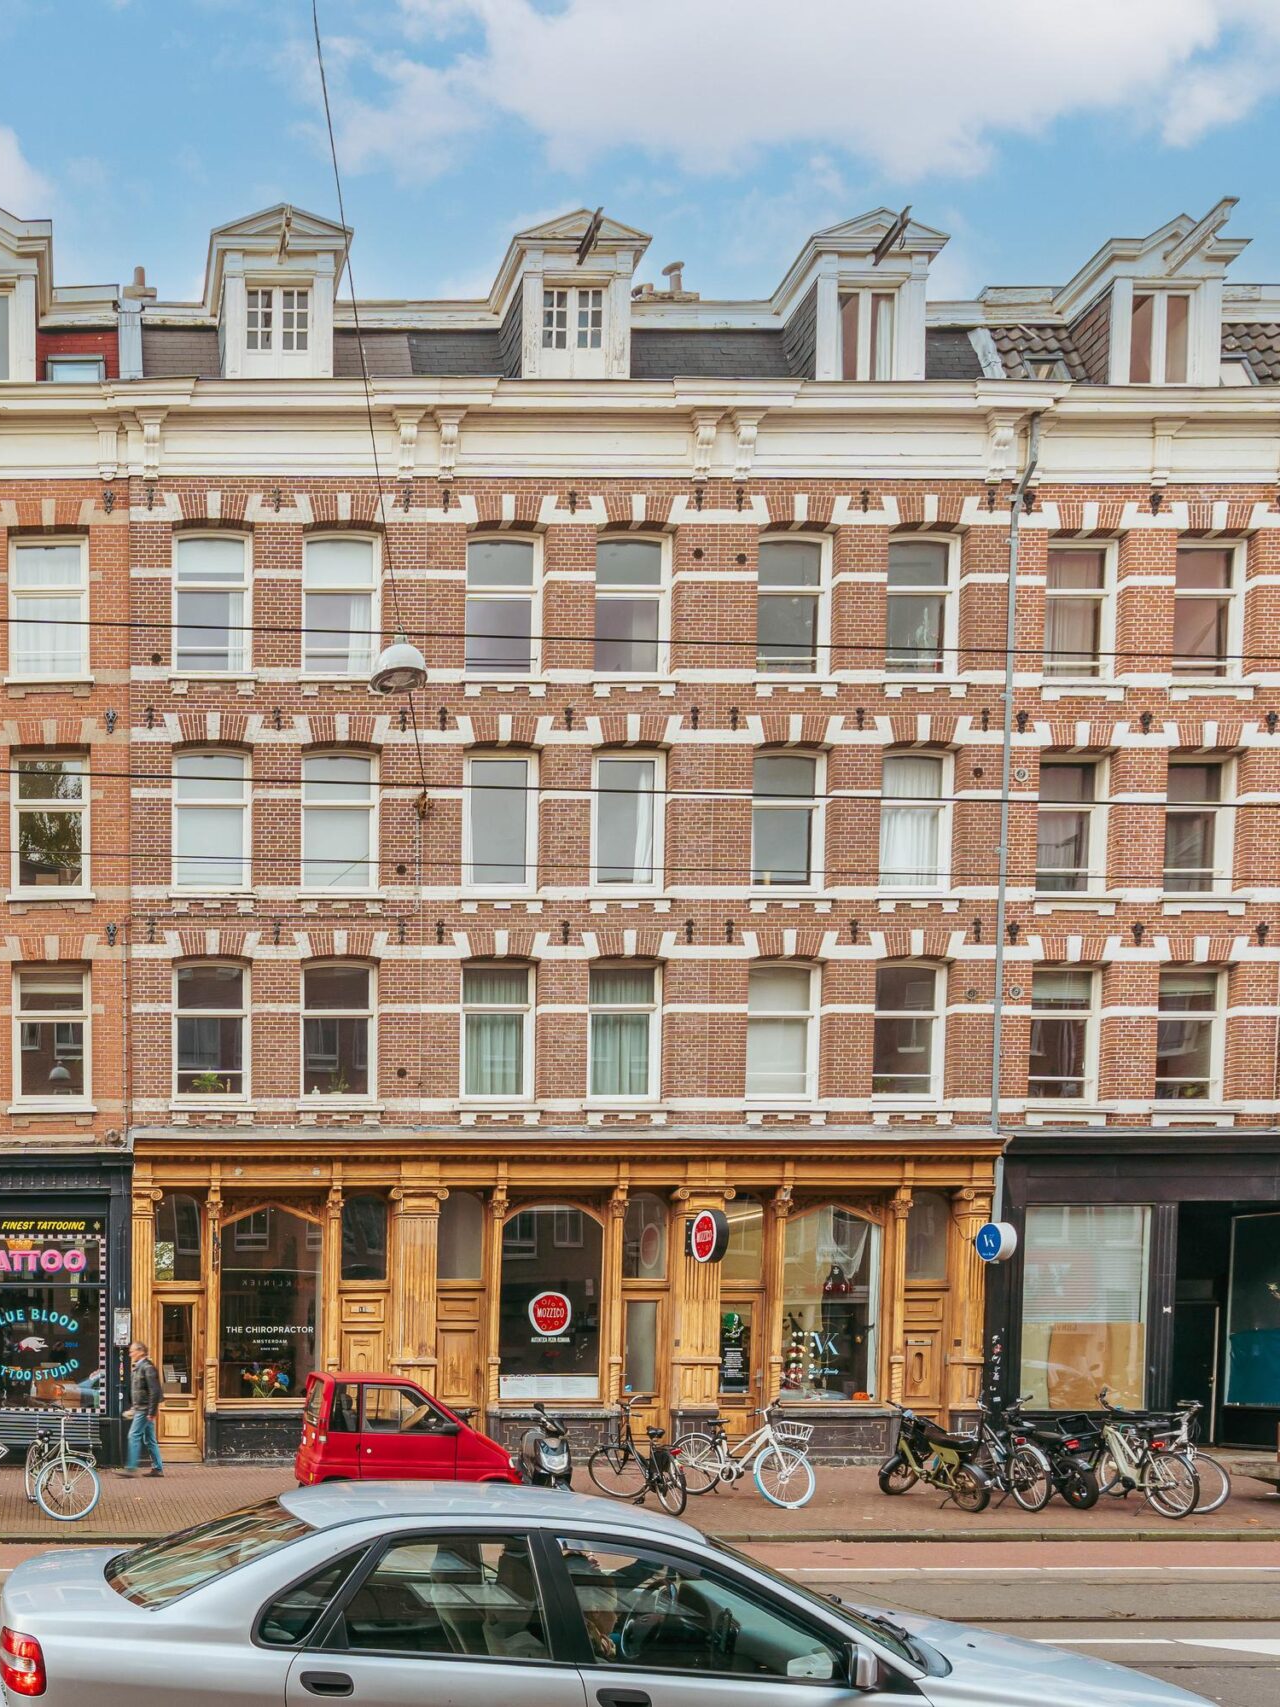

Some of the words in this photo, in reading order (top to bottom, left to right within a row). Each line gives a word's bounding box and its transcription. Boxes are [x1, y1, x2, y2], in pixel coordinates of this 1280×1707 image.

[1, 1220, 35, 1230] FINEST
[36, 1221, 86, 1231] TATTOOING
[537, 1307, 565, 1319] MOZZICO
[31, 1308, 79, 1332] BLOOD
[226, 1326, 243, 1334] THE
[245, 1326, 314, 1334] CHIROPRACTOR
[35, 1358, 80, 1381] STUDIO
